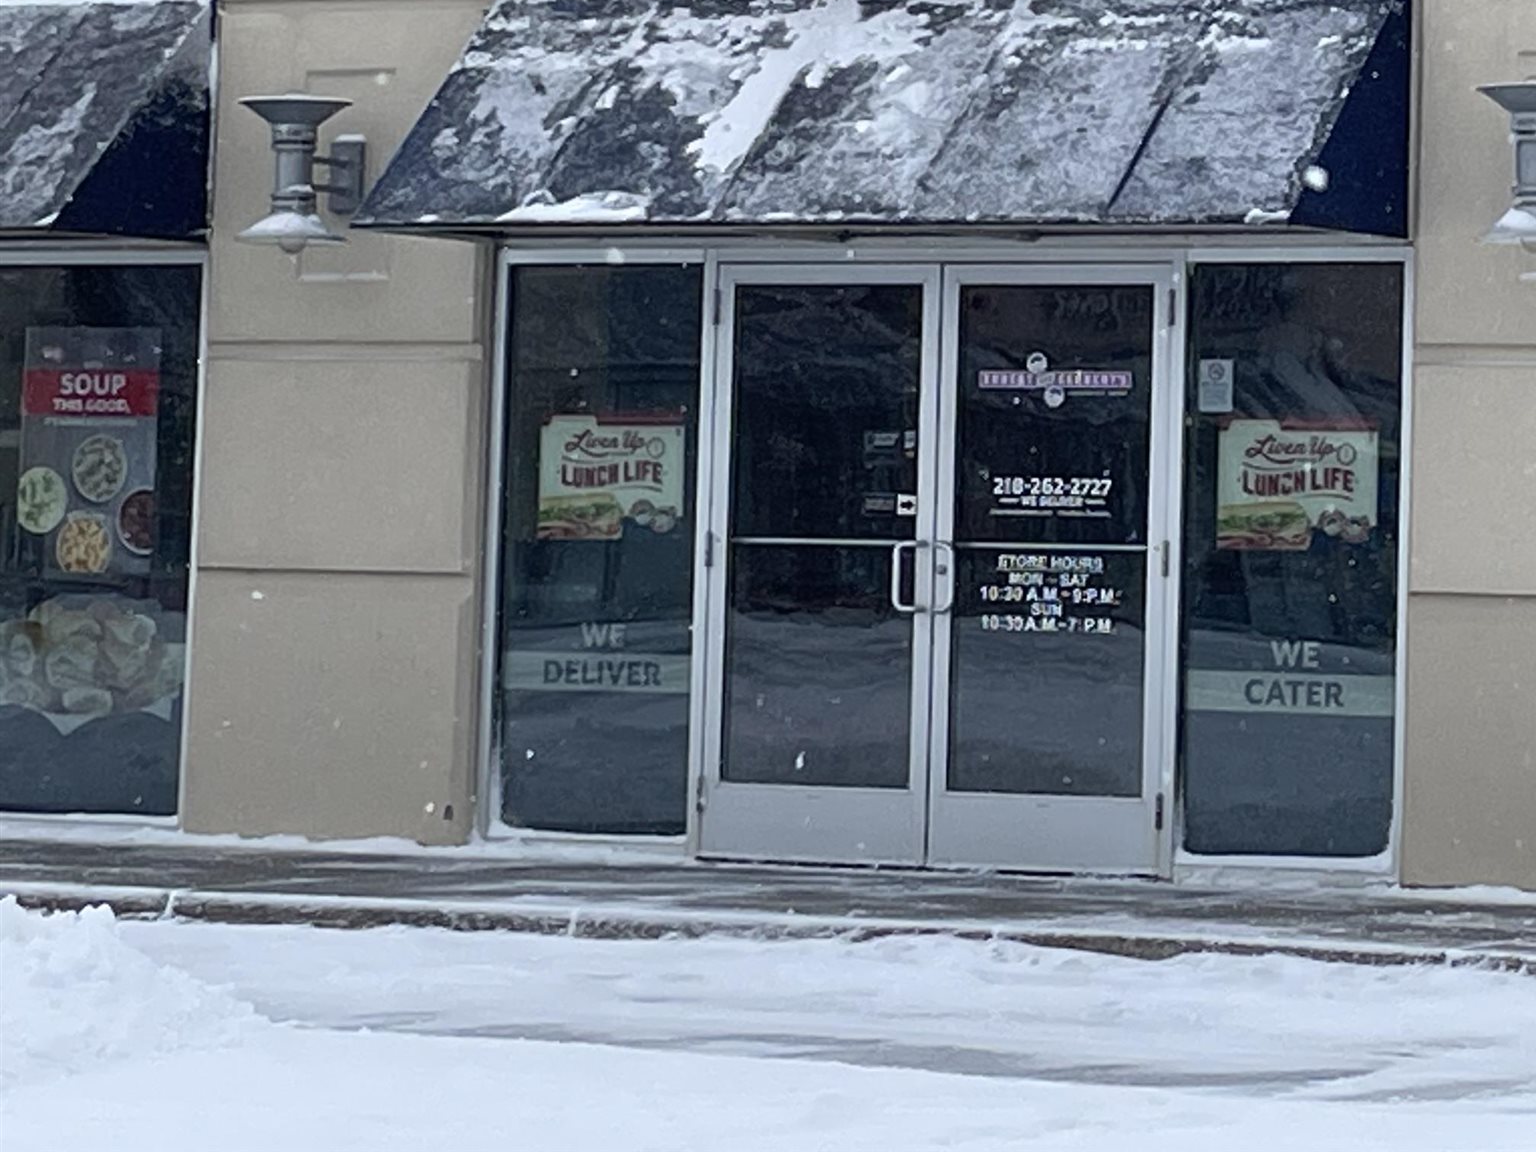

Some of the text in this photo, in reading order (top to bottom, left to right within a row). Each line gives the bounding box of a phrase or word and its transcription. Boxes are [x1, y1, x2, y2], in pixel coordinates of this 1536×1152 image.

[60, 372, 127, 396] SOUP
[561, 460, 663, 488] LUNCH LIFE
[1241, 467, 1355, 496] LUNCH LIFE
[1059, 573, 1090, 587] SAT
[1030, 602, 1062, 617] SUN
[580, 622, 628, 648] WE
[1270, 639, 1322, 668] WE
[542, 659, 663, 687] DELIVER
[1243, 679, 1345, 708] CATER
